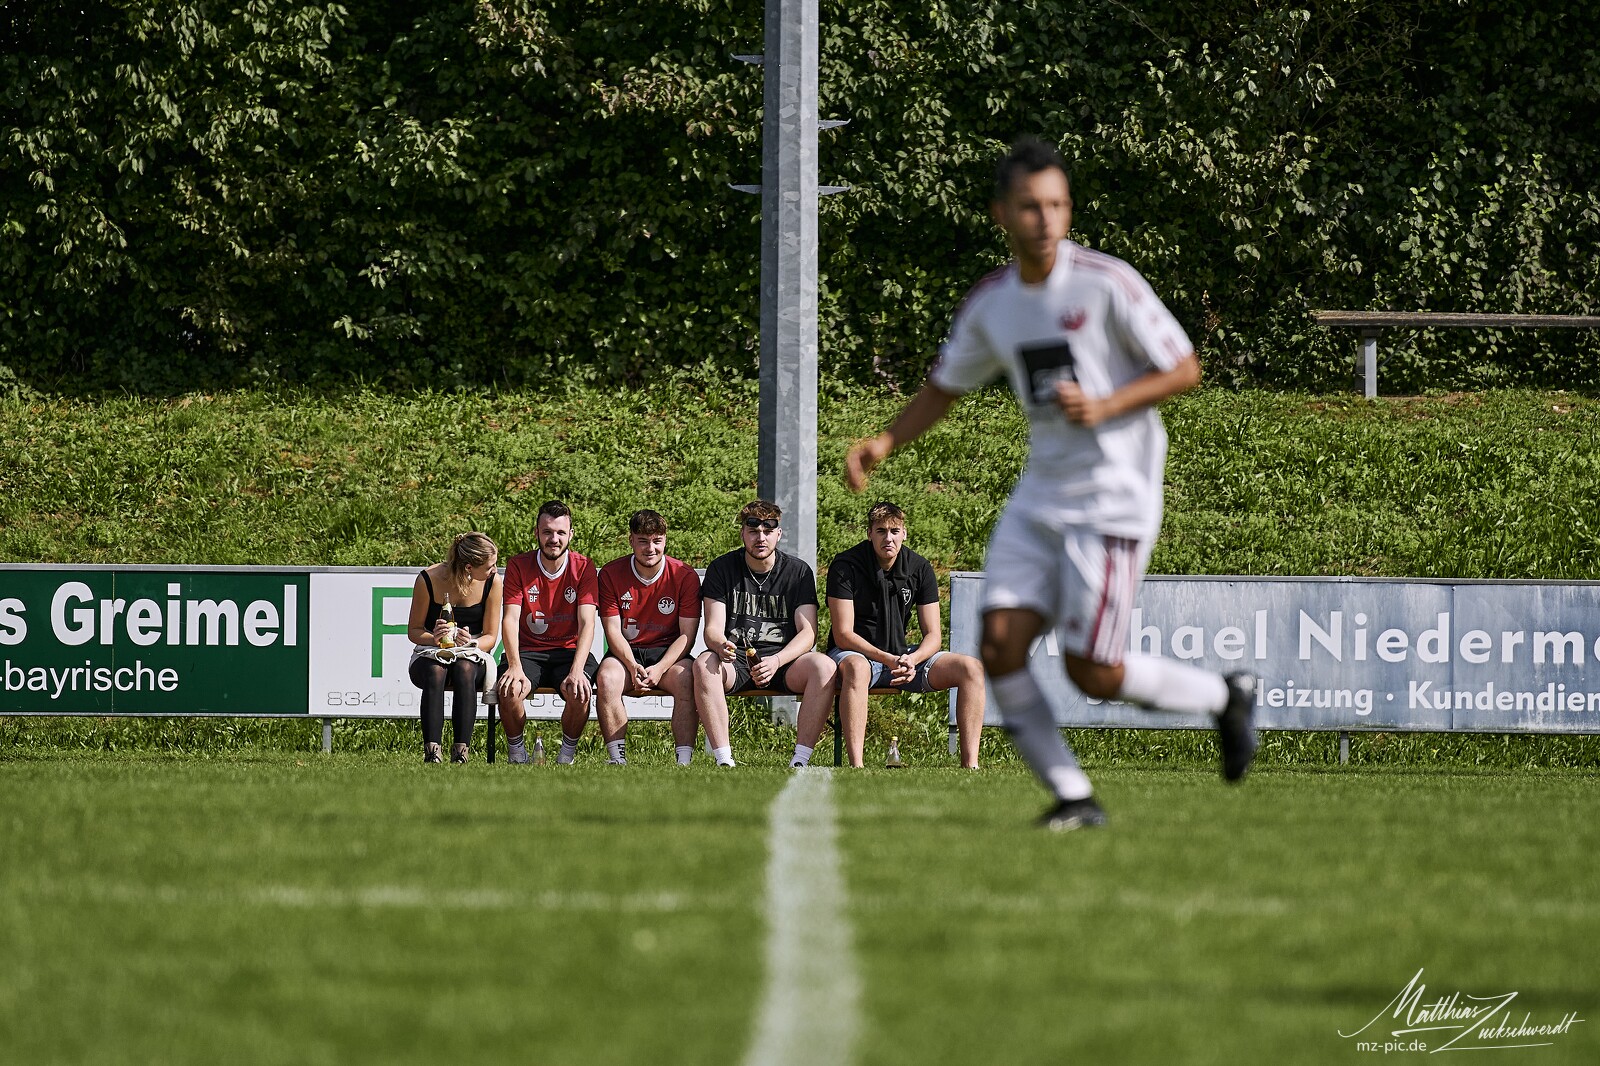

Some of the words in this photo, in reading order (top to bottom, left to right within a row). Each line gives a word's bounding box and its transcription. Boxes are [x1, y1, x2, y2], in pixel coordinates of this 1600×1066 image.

[51, 581, 297, 647] Greimel
[529, 595, 538, 603] BF
[621, 602, 631, 610] AK
[661, 599, 674, 609] SV
[727, 589, 788, 619] NIRVANA
[1030, 608, 1268, 660] hael
[1299, 609, 1600, 664] Niederm
[0, 660, 179, 699] bayrische
